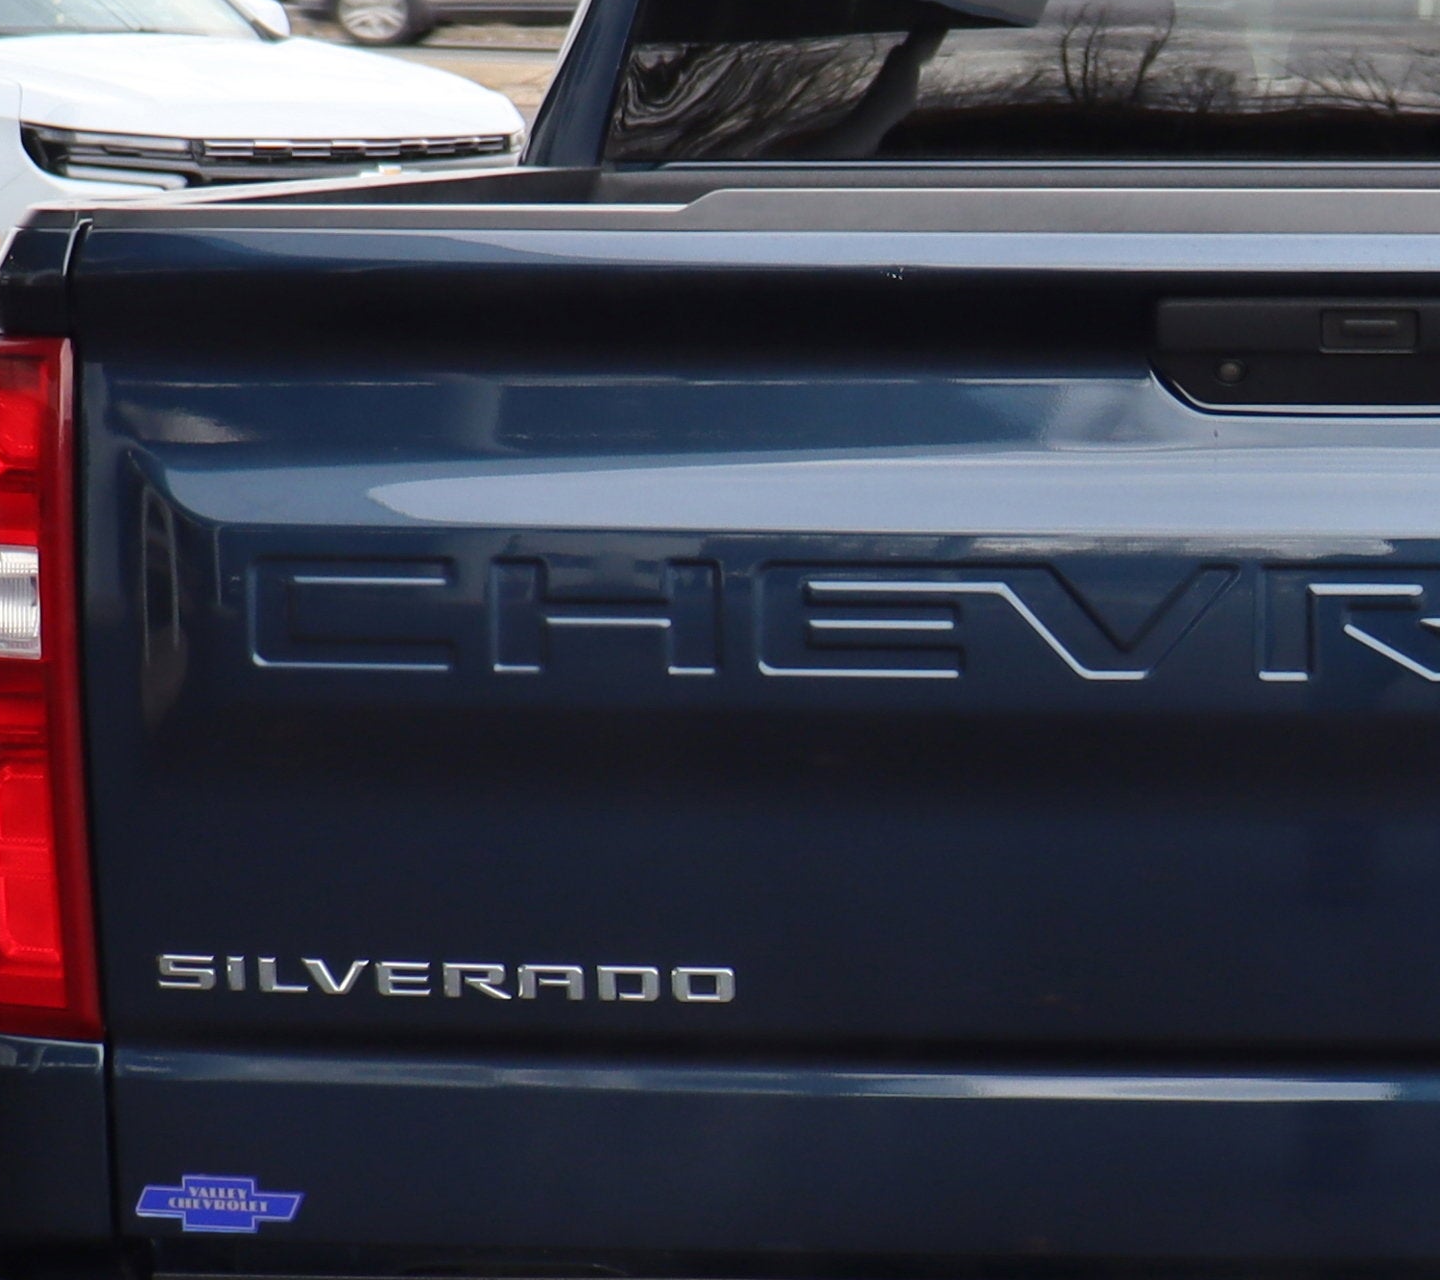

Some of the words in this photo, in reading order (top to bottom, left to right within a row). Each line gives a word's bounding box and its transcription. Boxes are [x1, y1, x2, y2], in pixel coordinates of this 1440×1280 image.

[157, 953, 736, 1003] SILVERADO
[189, 1186, 248, 1200] VALLEY
[167, 1197, 268, 1213] CHEVROLET
